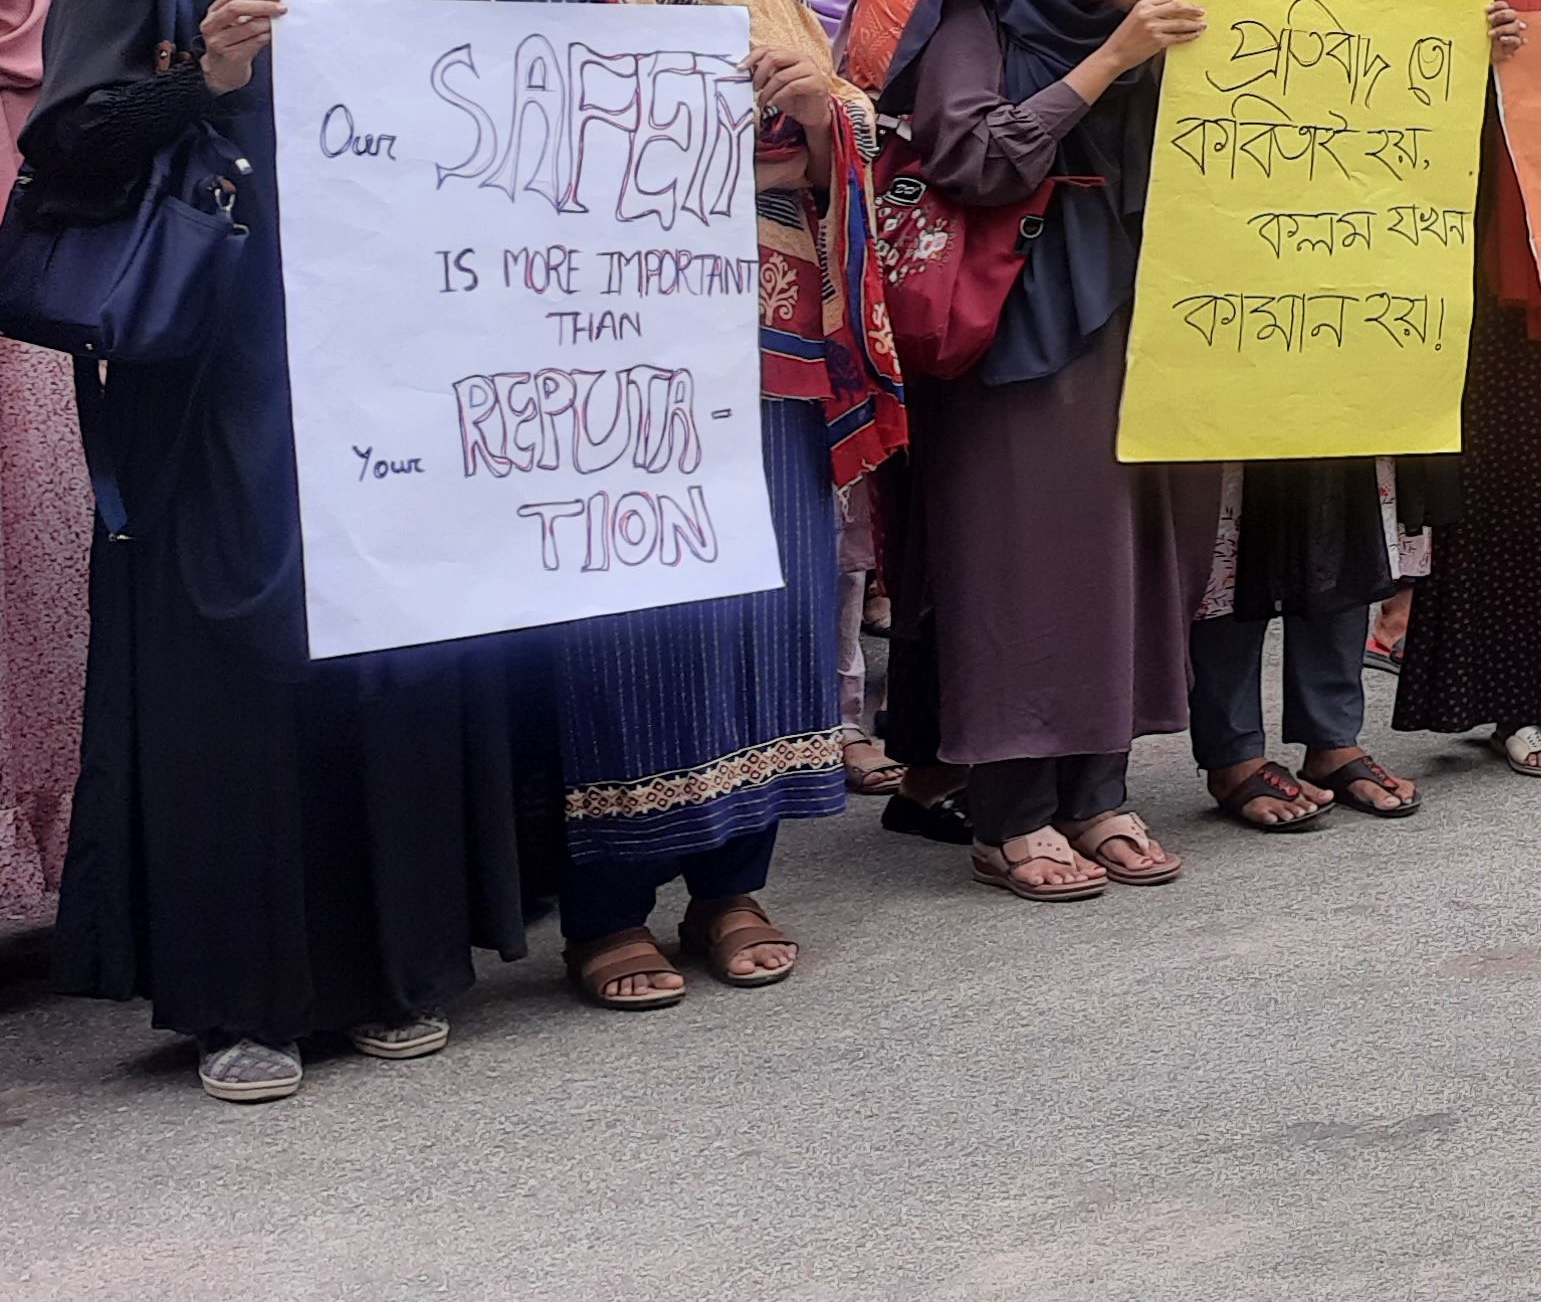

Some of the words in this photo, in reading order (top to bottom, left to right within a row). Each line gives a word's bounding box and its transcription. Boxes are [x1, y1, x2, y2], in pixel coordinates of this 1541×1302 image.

[1407, 36, 1453, 106] তো
[320, 103, 397, 161] Our
[431, 33, 756, 231] SAFETY
[1171, 93, 1359, 181] কবিতাই
[1365, 127, 1434, 181] হয়,
[1247, 210, 1378, 259] কলম
[1387, 204, 1472, 247] যখন
[435, 247, 479, 294] IS
[503, 244, 584, 296] MORE
[596, 247, 760, 298] IMPORTANT
[546, 311, 643, 346] THAN
[1172, 293, 1360, 353] কামান
[1364, 293, 1446, 352] হয়!
[352, 444, 426, 482] Your
[517, 485, 719, 573] TION
